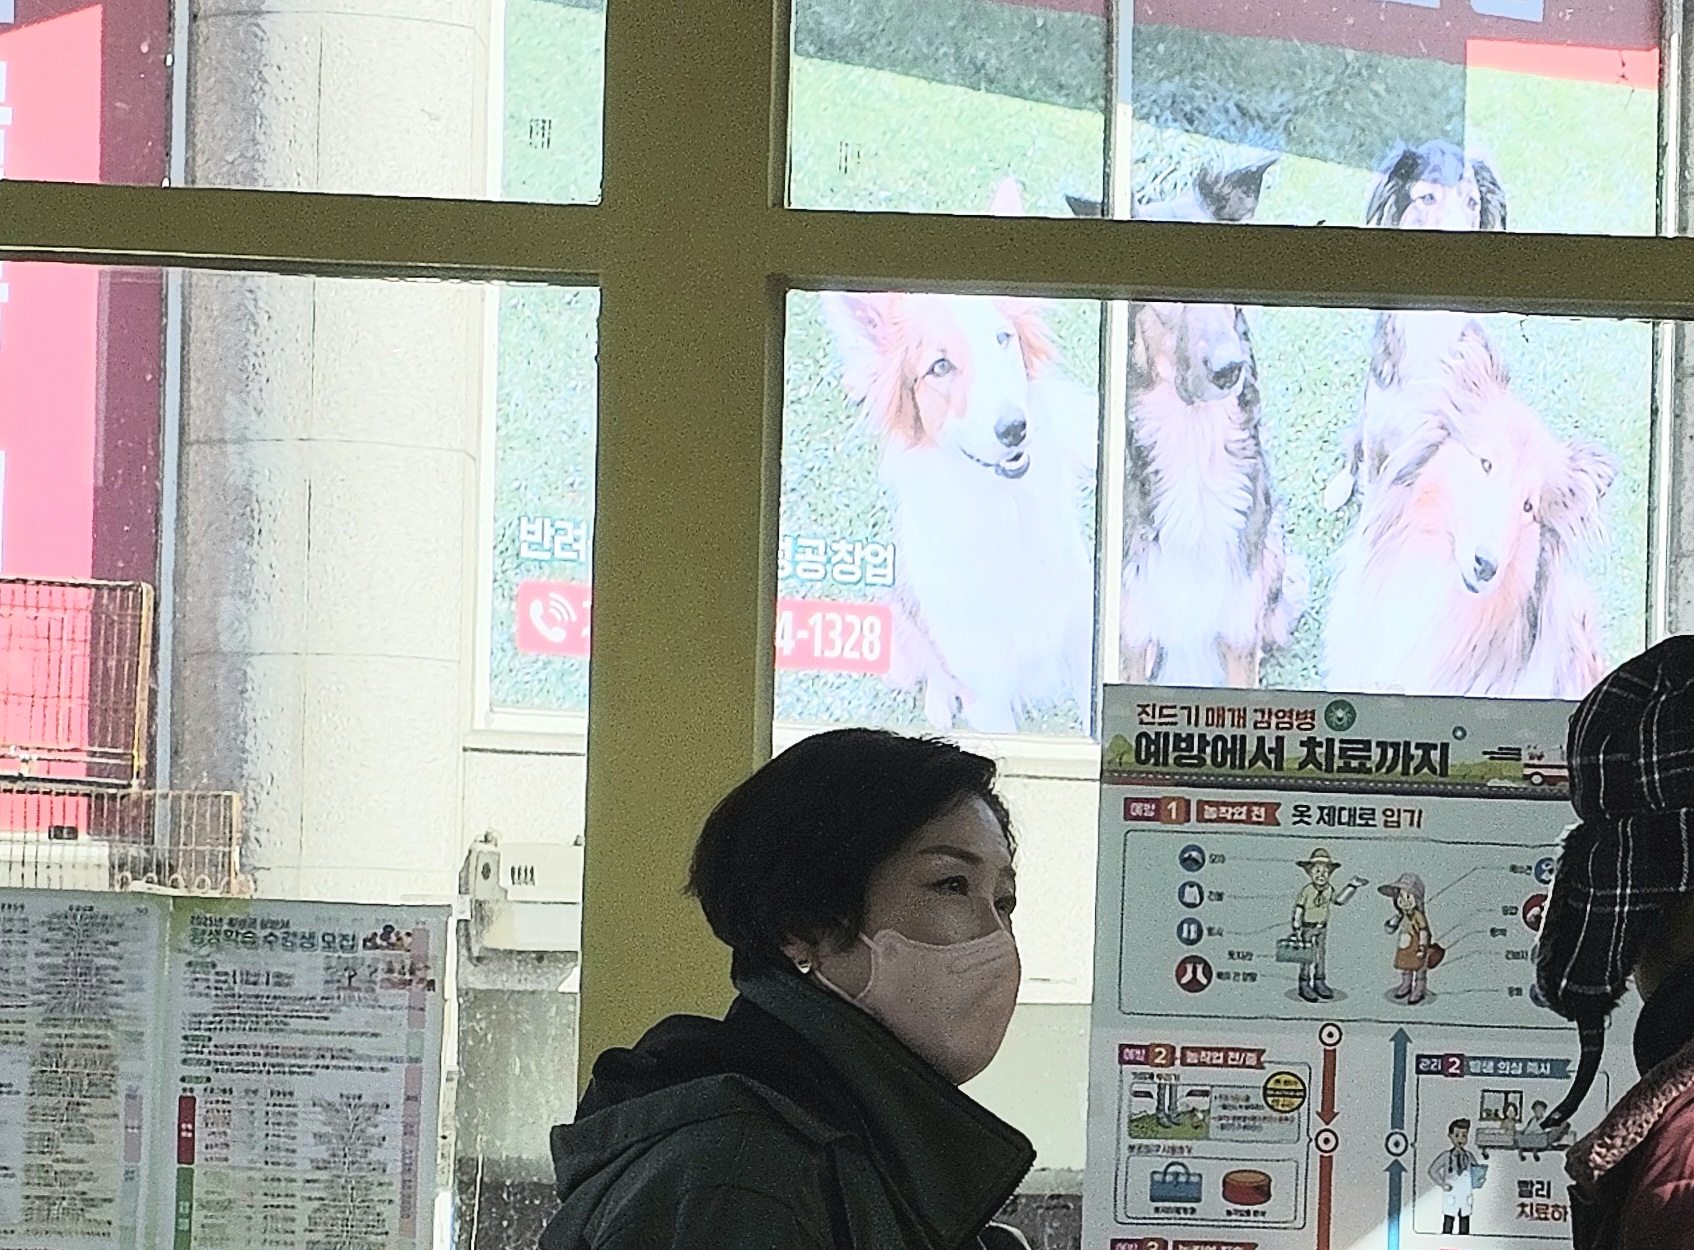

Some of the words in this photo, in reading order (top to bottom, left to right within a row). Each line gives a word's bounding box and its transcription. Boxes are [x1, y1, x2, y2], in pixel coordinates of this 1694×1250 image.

[519, 516, 589, 562] 반려
[1136, 703, 1200, 727] 진드기
[1204, 706, 1247, 729] 매개
[1252, 707, 1317, 731] 감염병
[1134, 731, 1286, 771] 예방에서
[1298, 736, 1450, 778] 치료까지
[1166, 801, 1178, 819] 1
[1203, 804, 1247, 821] 농작업
[1251, 806, 1267, 822] 전
[1291, 804, 1313, 826] 옷
[1316, 806, 1378, 828] 제대로
[1382, 808, 1424, 829] 입기
[321, 931, 358, 951] 모집
[1153, 1047, 1167, 1065] 2
[1448, 1057, 1461, 1074] 2
[1497, 1060, 1523, 1075] 의심
[1517, 1180, 1551, 1199] 빨리
